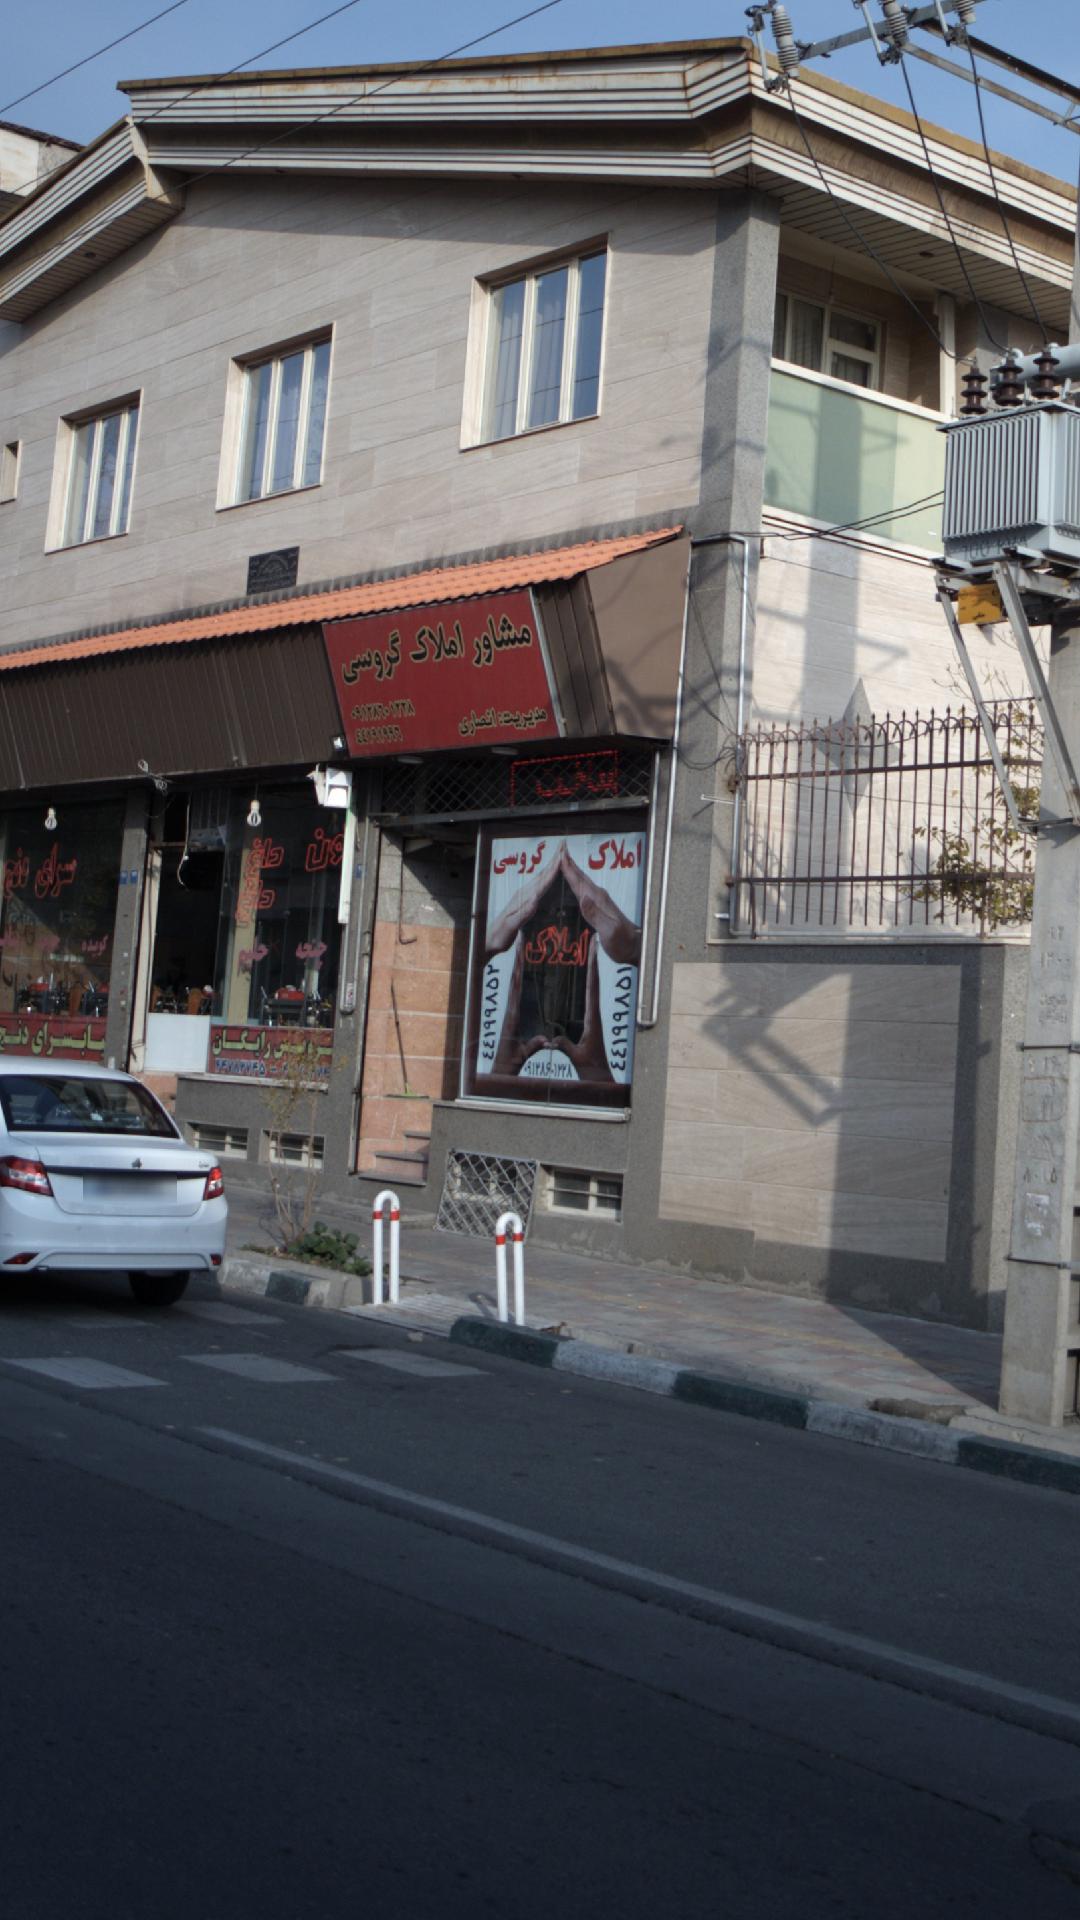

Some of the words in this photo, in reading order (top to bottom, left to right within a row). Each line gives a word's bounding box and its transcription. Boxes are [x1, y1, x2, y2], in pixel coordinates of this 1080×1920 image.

[342, 630, 402, 685] گروسی
[409, 620, 465, 663] املاک
[472, 615, 533, 669] مشاور
[459, 707, 497, 737] انصاری
[498, 707, 547, 731] مدیریت:
[493, 840, 546, 875] گروسی
[588, 839, 643, 871] املاک
[525, 925, 589, 967] املاک
